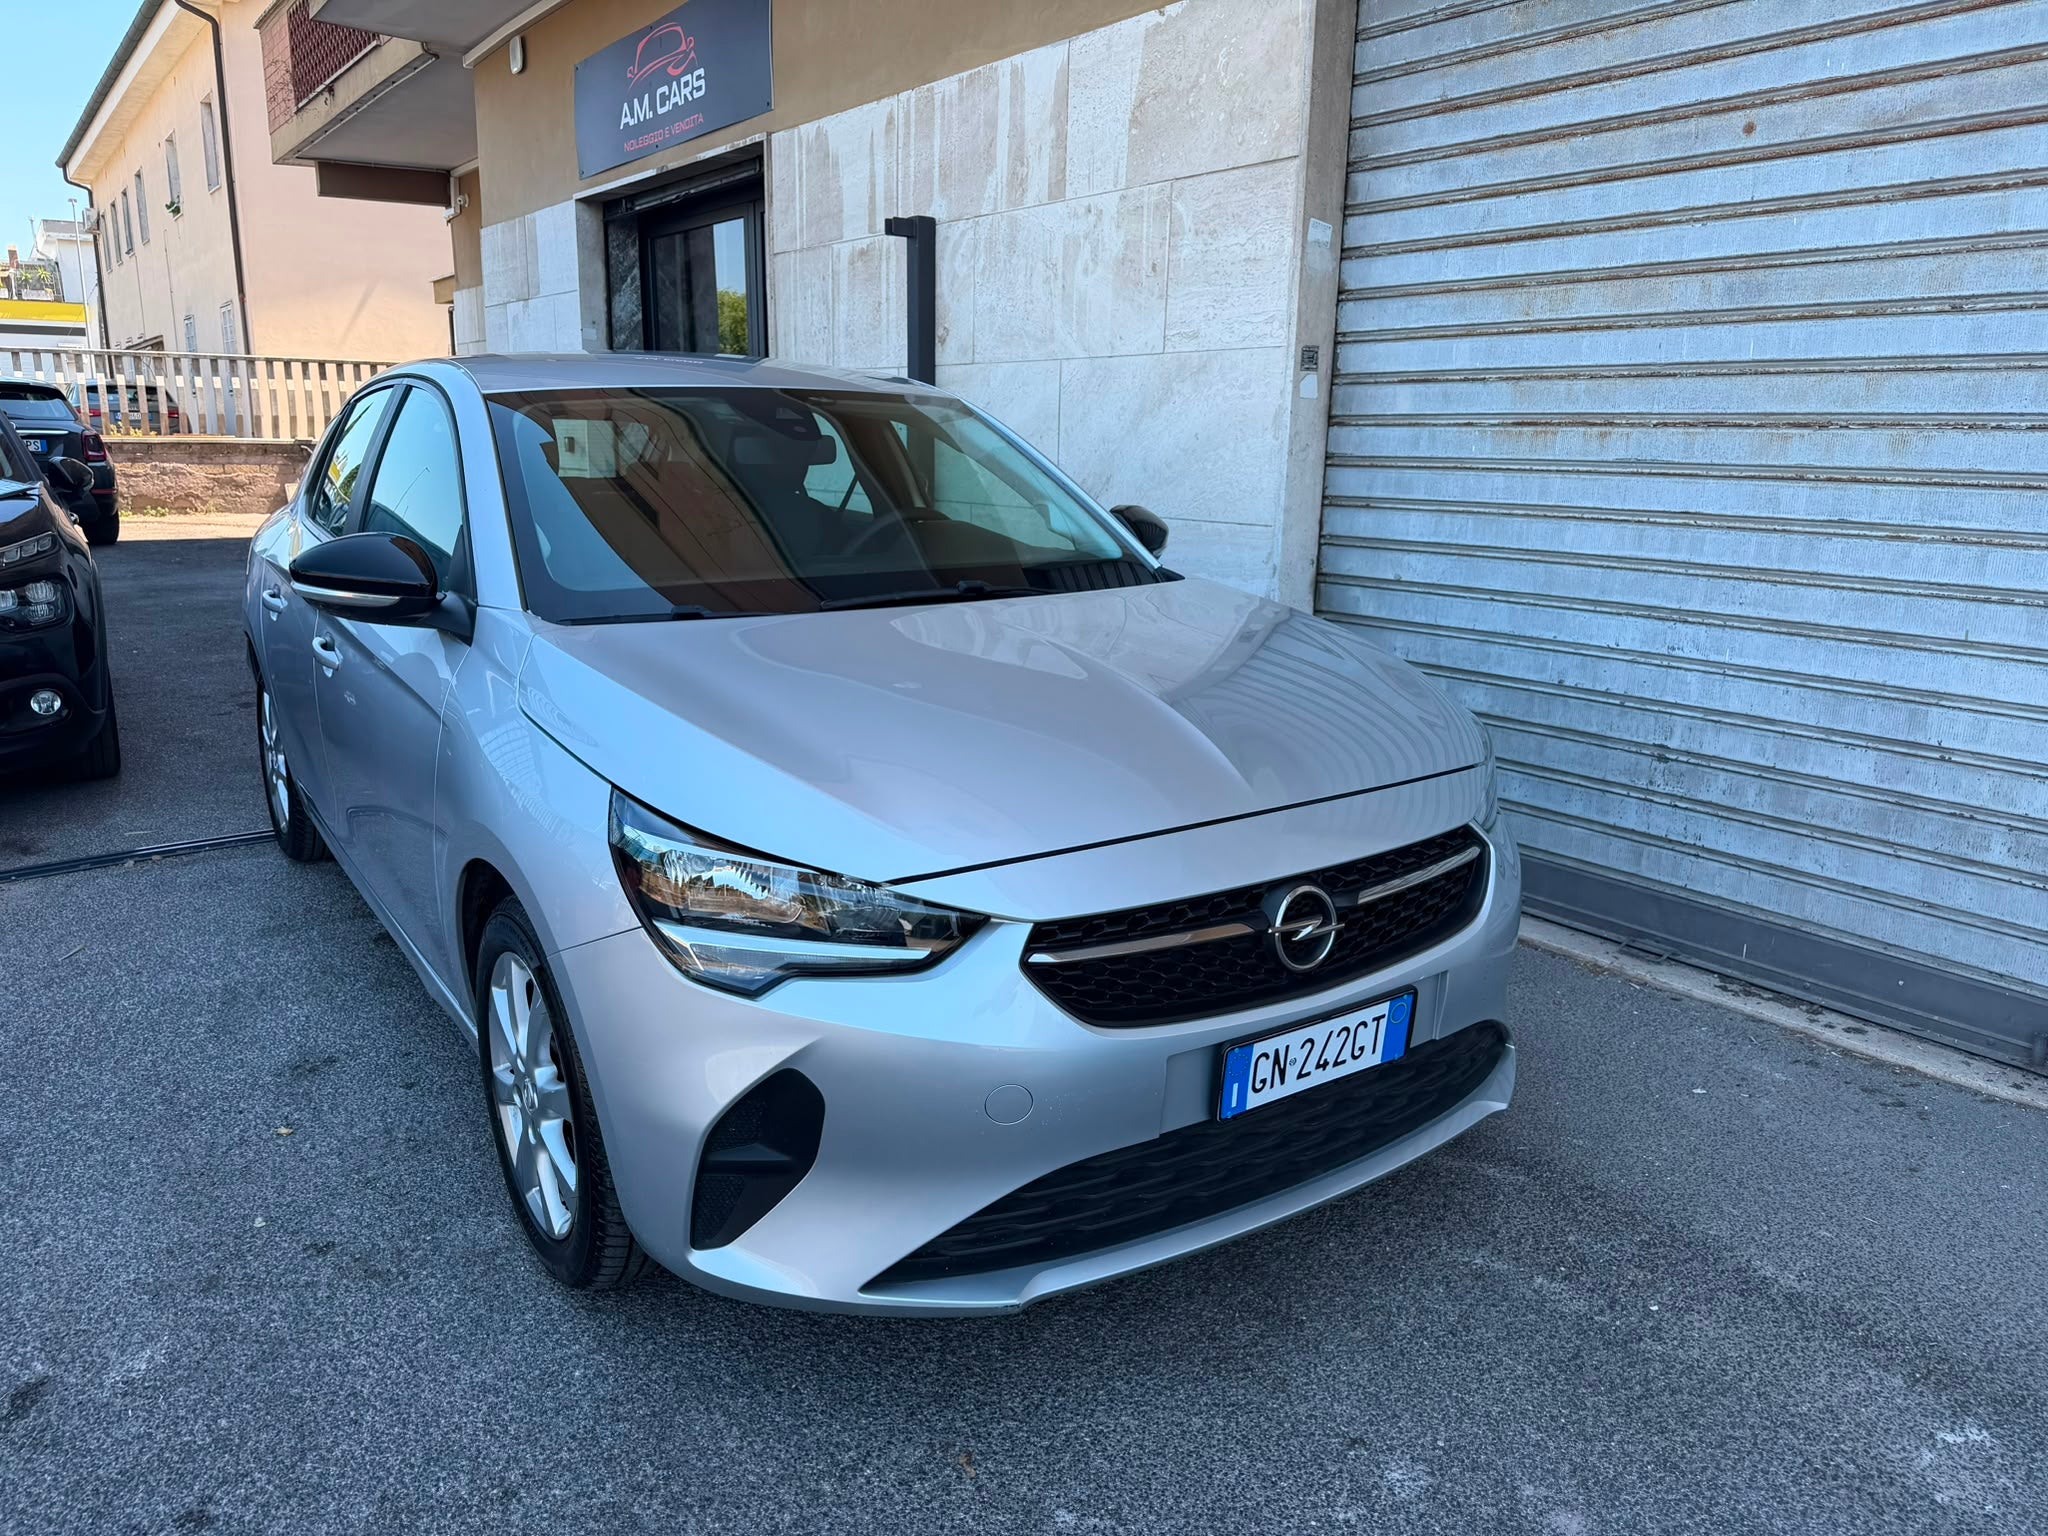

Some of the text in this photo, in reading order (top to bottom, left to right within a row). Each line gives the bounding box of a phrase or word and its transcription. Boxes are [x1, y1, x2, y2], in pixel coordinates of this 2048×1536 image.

[619, 67, 706, 130] A.M. CARS
[623, 113, 705, 152] NOLEGGIO E VENDITA
